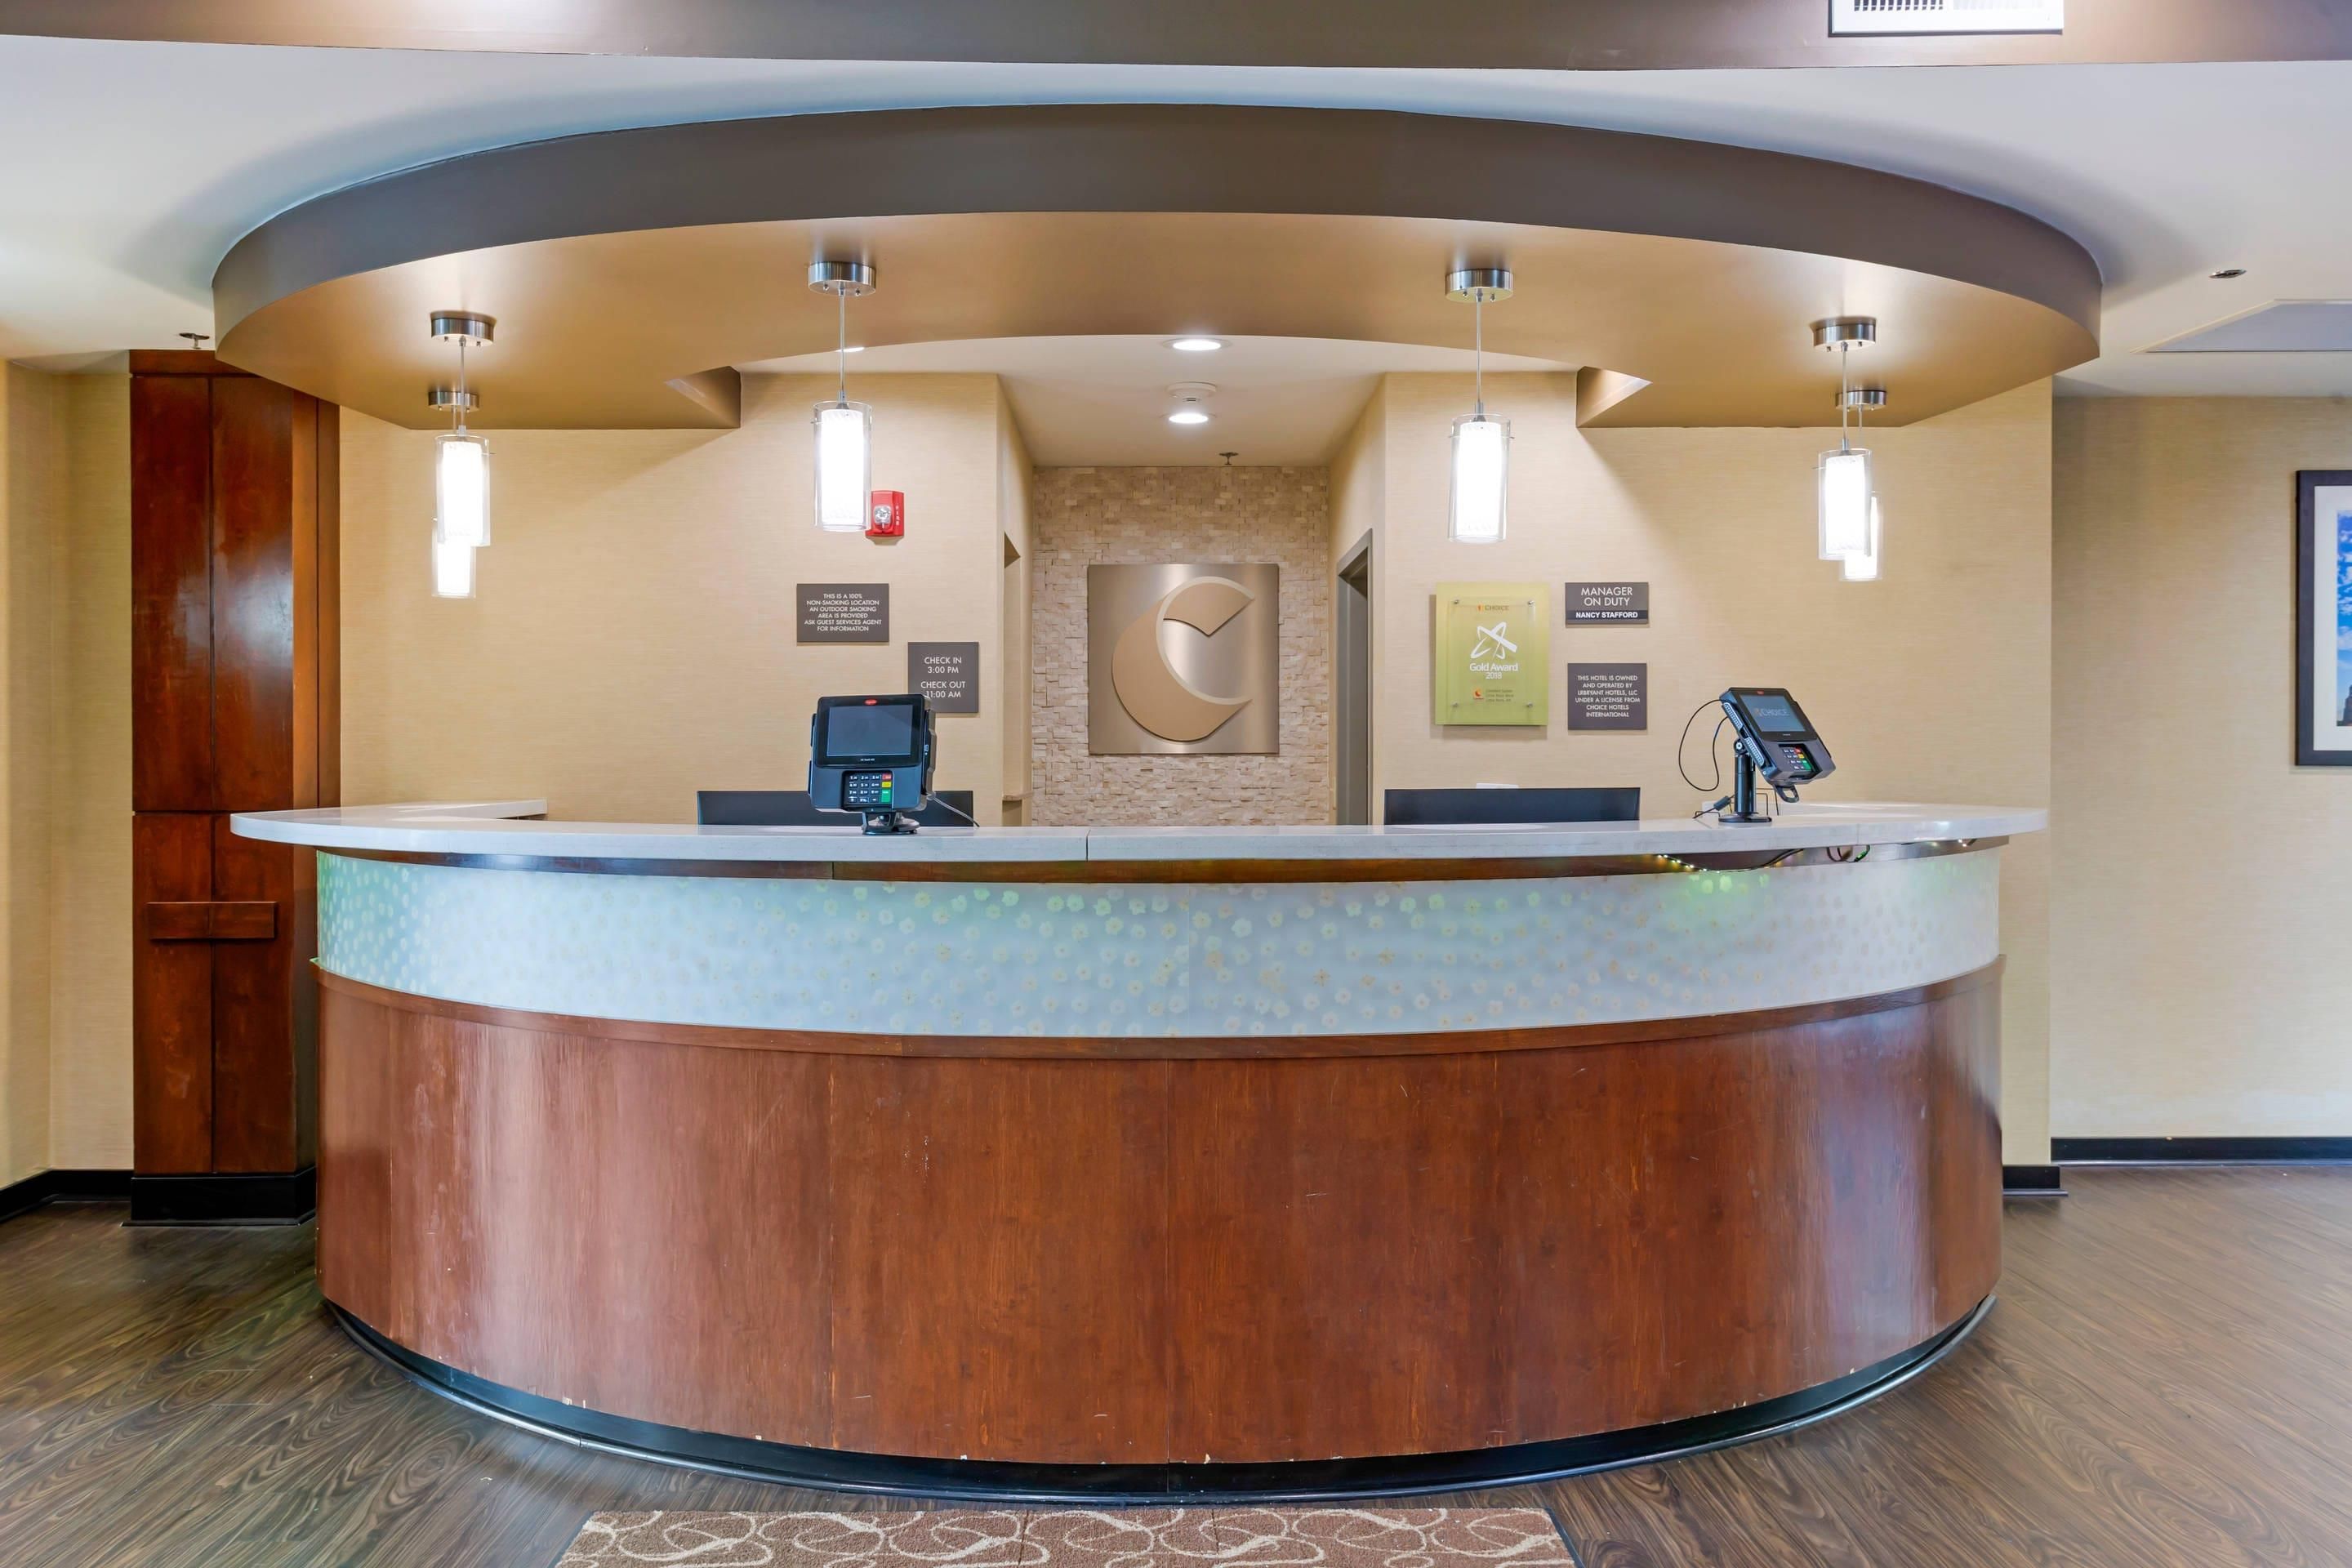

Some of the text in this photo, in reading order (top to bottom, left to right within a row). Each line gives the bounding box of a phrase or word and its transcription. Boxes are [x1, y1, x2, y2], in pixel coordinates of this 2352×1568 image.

[1581, 586, 1633, 596] MANAGER
[1584, 597, 1630, 606] ON DUTY
[1469, 663, 1518, 671] Gold Award
